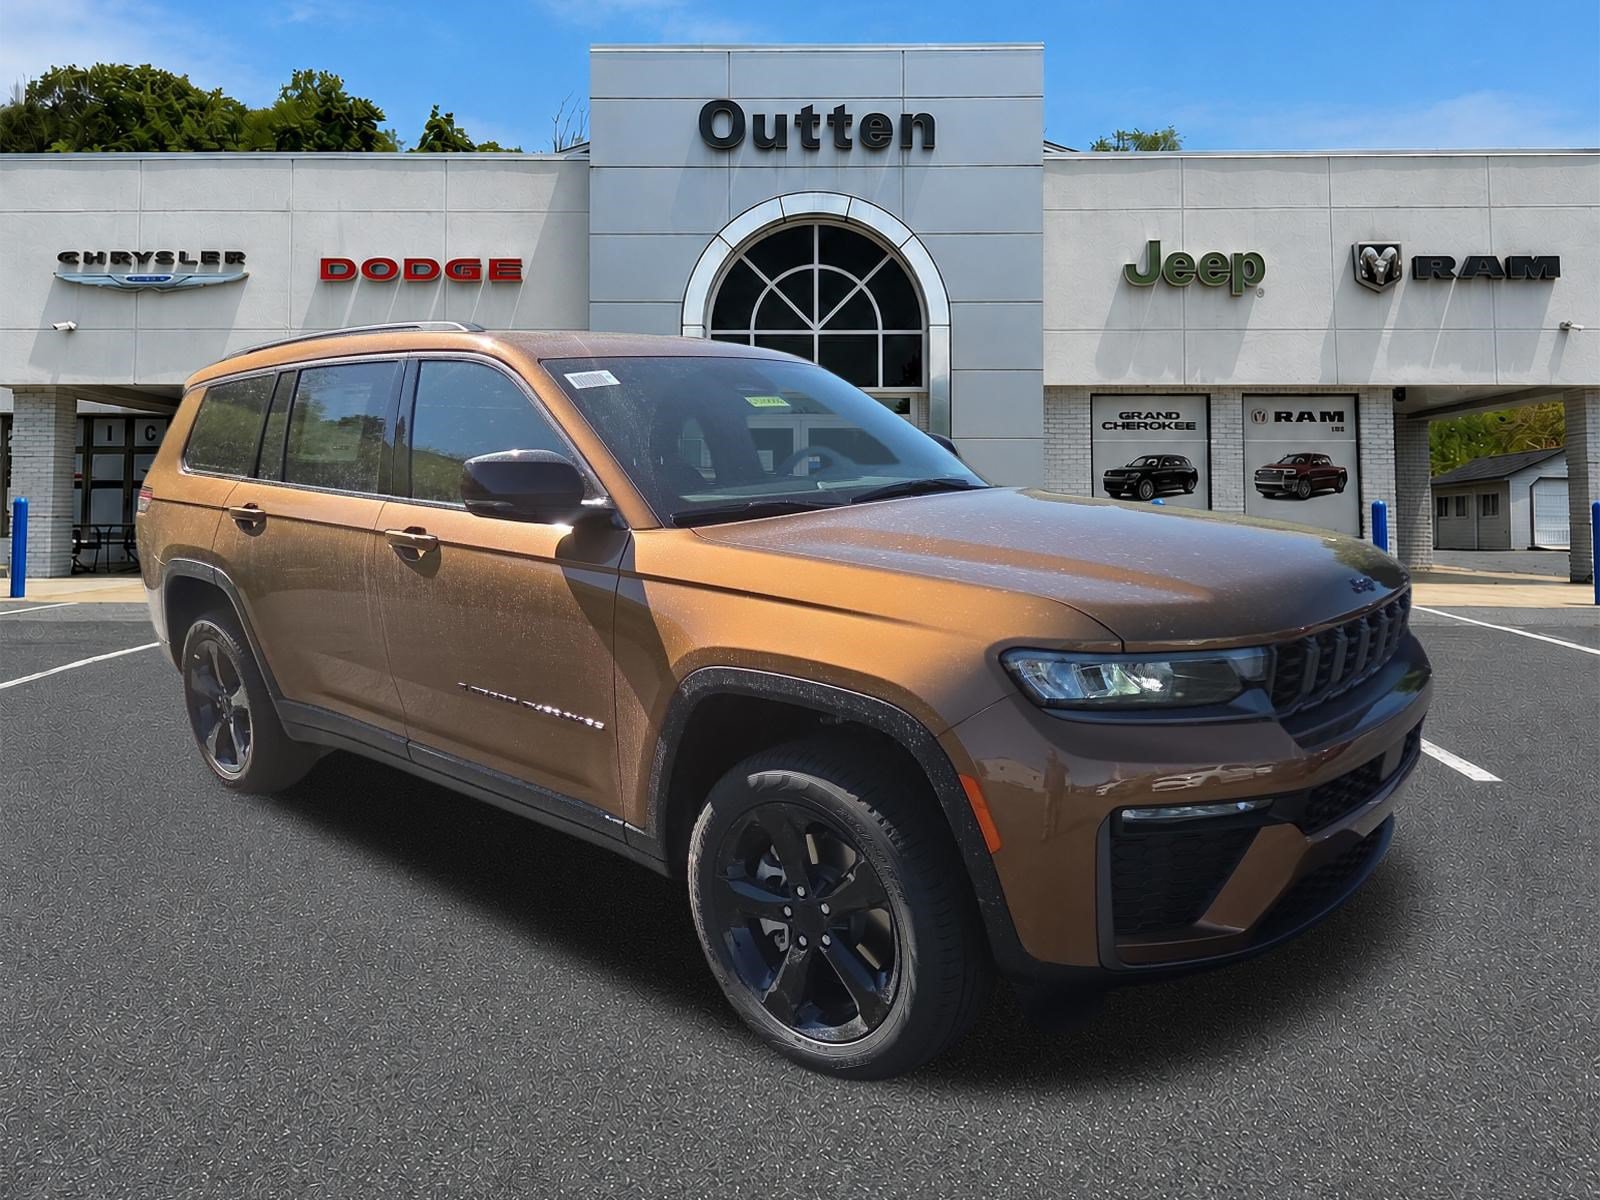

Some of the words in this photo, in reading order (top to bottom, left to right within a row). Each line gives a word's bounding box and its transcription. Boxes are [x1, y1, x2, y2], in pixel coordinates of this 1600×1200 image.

[699, 99, 936, 150] Outten
[57, 250, 247, 266] CHRYSLER
[1123, 240, 1266, 296] Jeep
[1411, 255, 1560, 280] RAM
[319, 257, 523, 283] DODGE
[1118, 411, 1181, 420] GRAND
[1273, 410, 1345, 423] RAM
[1101, 421, 1197, 431] CHEROKEE
